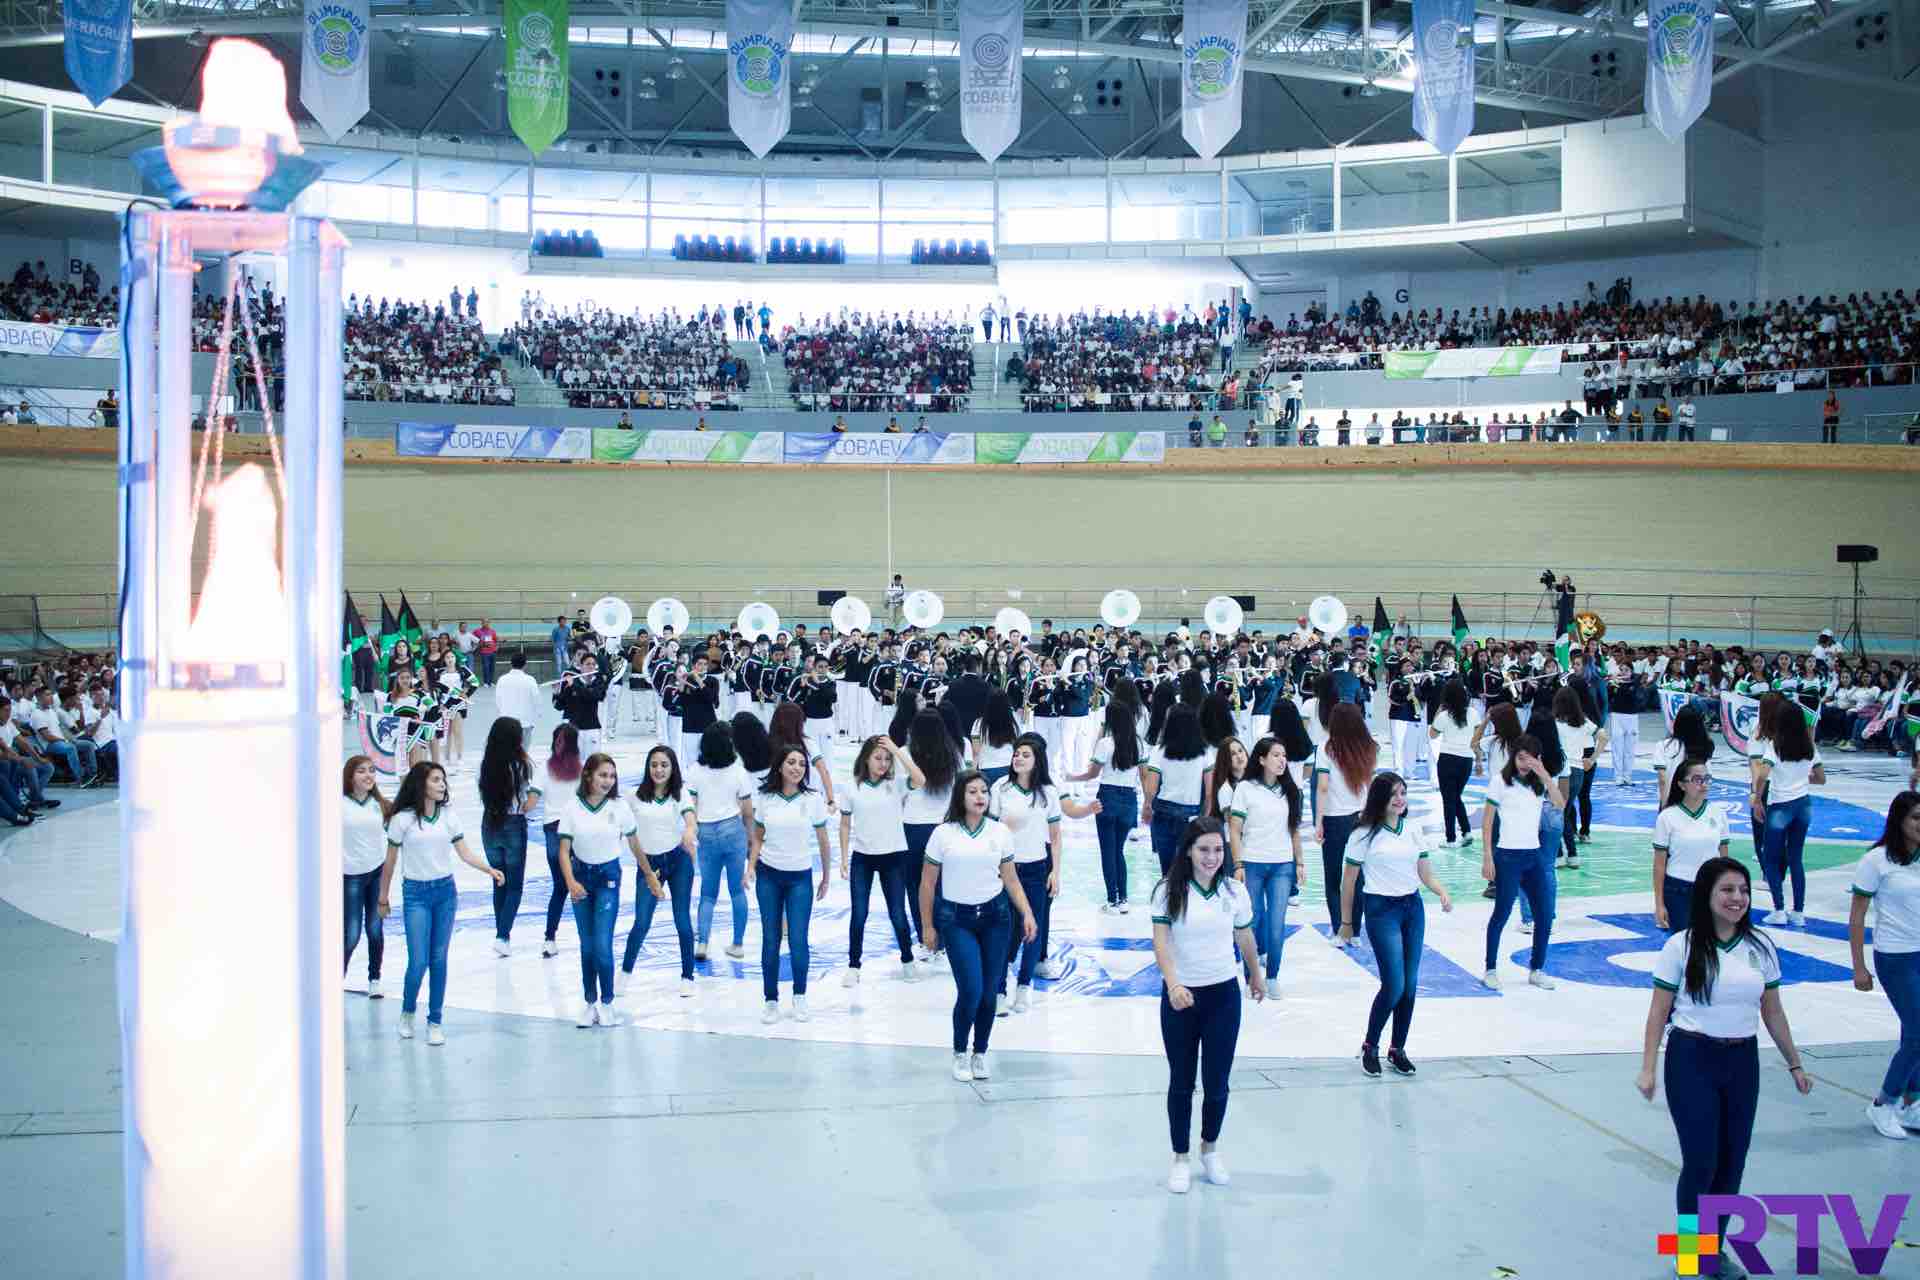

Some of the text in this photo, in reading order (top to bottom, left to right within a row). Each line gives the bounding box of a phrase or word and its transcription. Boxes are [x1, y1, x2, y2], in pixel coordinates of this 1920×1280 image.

[308, 4, 367, 35] OLIMPIADA
[730, 34, 786, 59] OLIMPIADA
[70, 259, 83, 274] B
[1395, 289, 1409, 304] G
[448, 431, 519, 449] COBAEV
[833, 439, 904, 457] COBAEV
